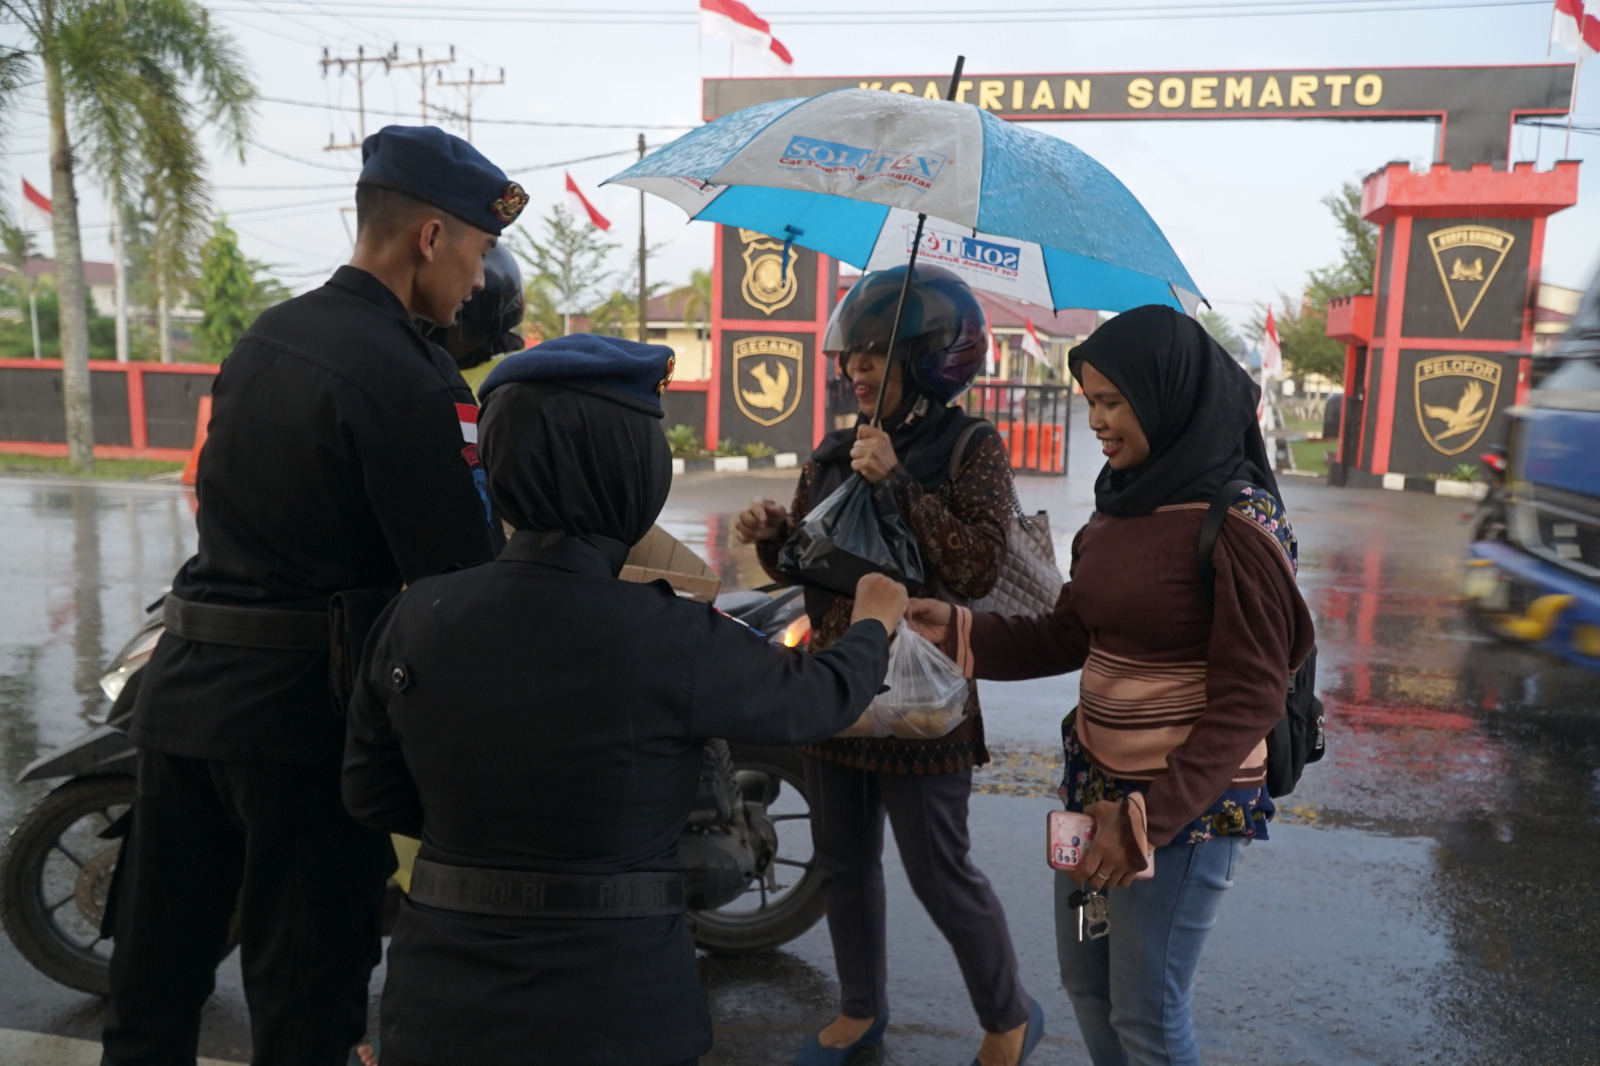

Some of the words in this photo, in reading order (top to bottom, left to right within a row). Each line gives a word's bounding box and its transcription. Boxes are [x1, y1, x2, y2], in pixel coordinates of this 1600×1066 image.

[859, 79, 1091, 110] ATRIAN
[1127, 74, 1382, 109] SOEMARTO
[1423, 360, 1496, 379] PELOPOR
